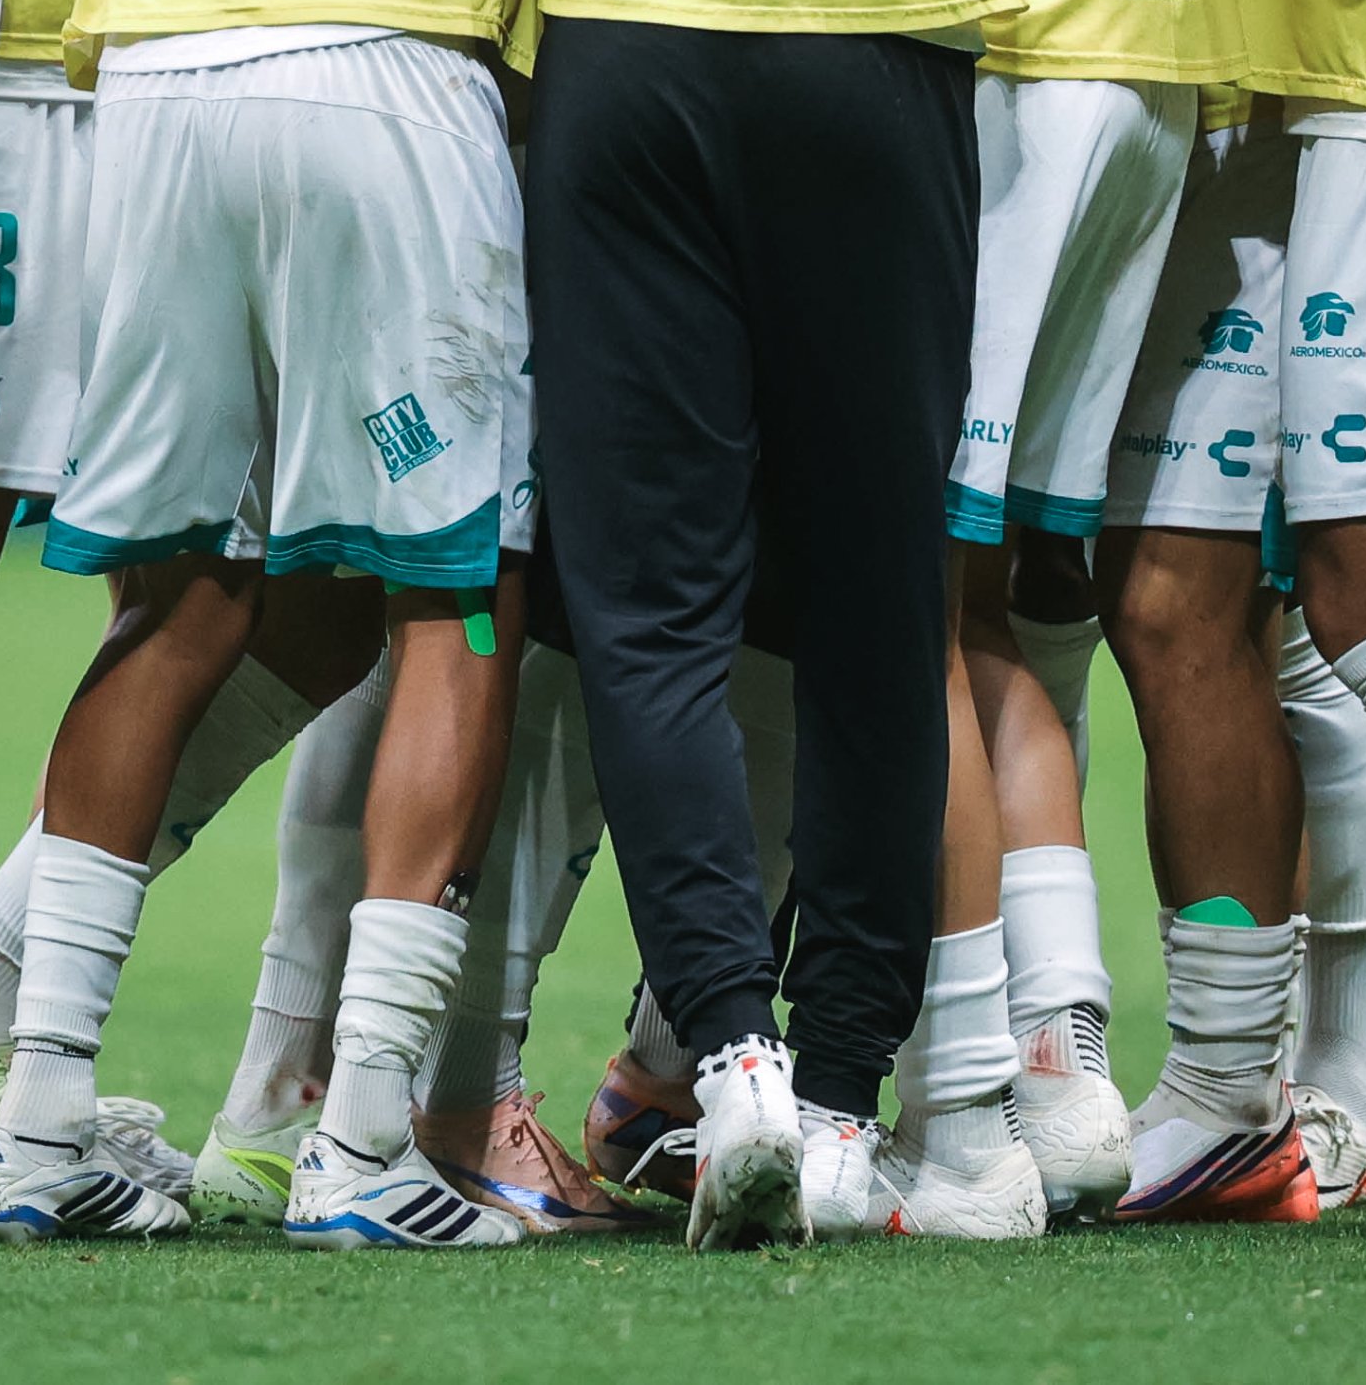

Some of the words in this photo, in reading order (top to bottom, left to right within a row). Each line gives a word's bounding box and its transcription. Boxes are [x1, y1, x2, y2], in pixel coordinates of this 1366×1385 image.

[1290, 346, 1363, 358] AEROMEXICO
[1182, 357, 1266, 376] AEROMEXICO
[368, 398, 418, 444] CITY
[962, 418, 1013, 444] ARLY
[380, 422, 437, 471] CLUB
